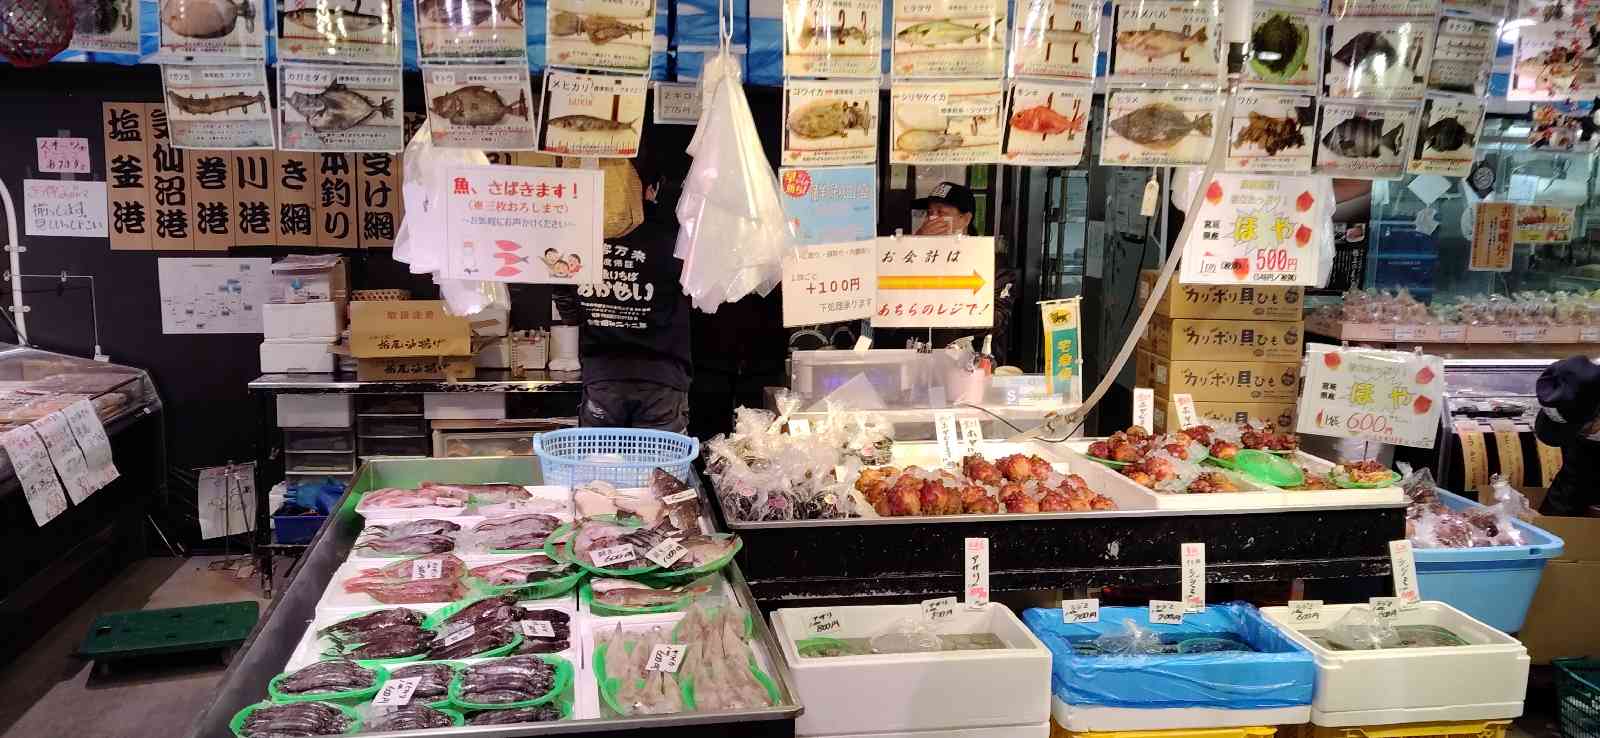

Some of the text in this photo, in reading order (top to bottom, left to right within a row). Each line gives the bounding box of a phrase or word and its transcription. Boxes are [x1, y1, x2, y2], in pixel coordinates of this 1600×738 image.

[109, 108, 146, 234] 塩釜港
[881, 249, 961, 264] お会計は
[1183, 286, 1279, 306] カリポリ貝ひも
[1185, 328, 1279, 347] カリポリ貝ひも
[1182, 369, 1276, 388] カリポリ貝ひも
